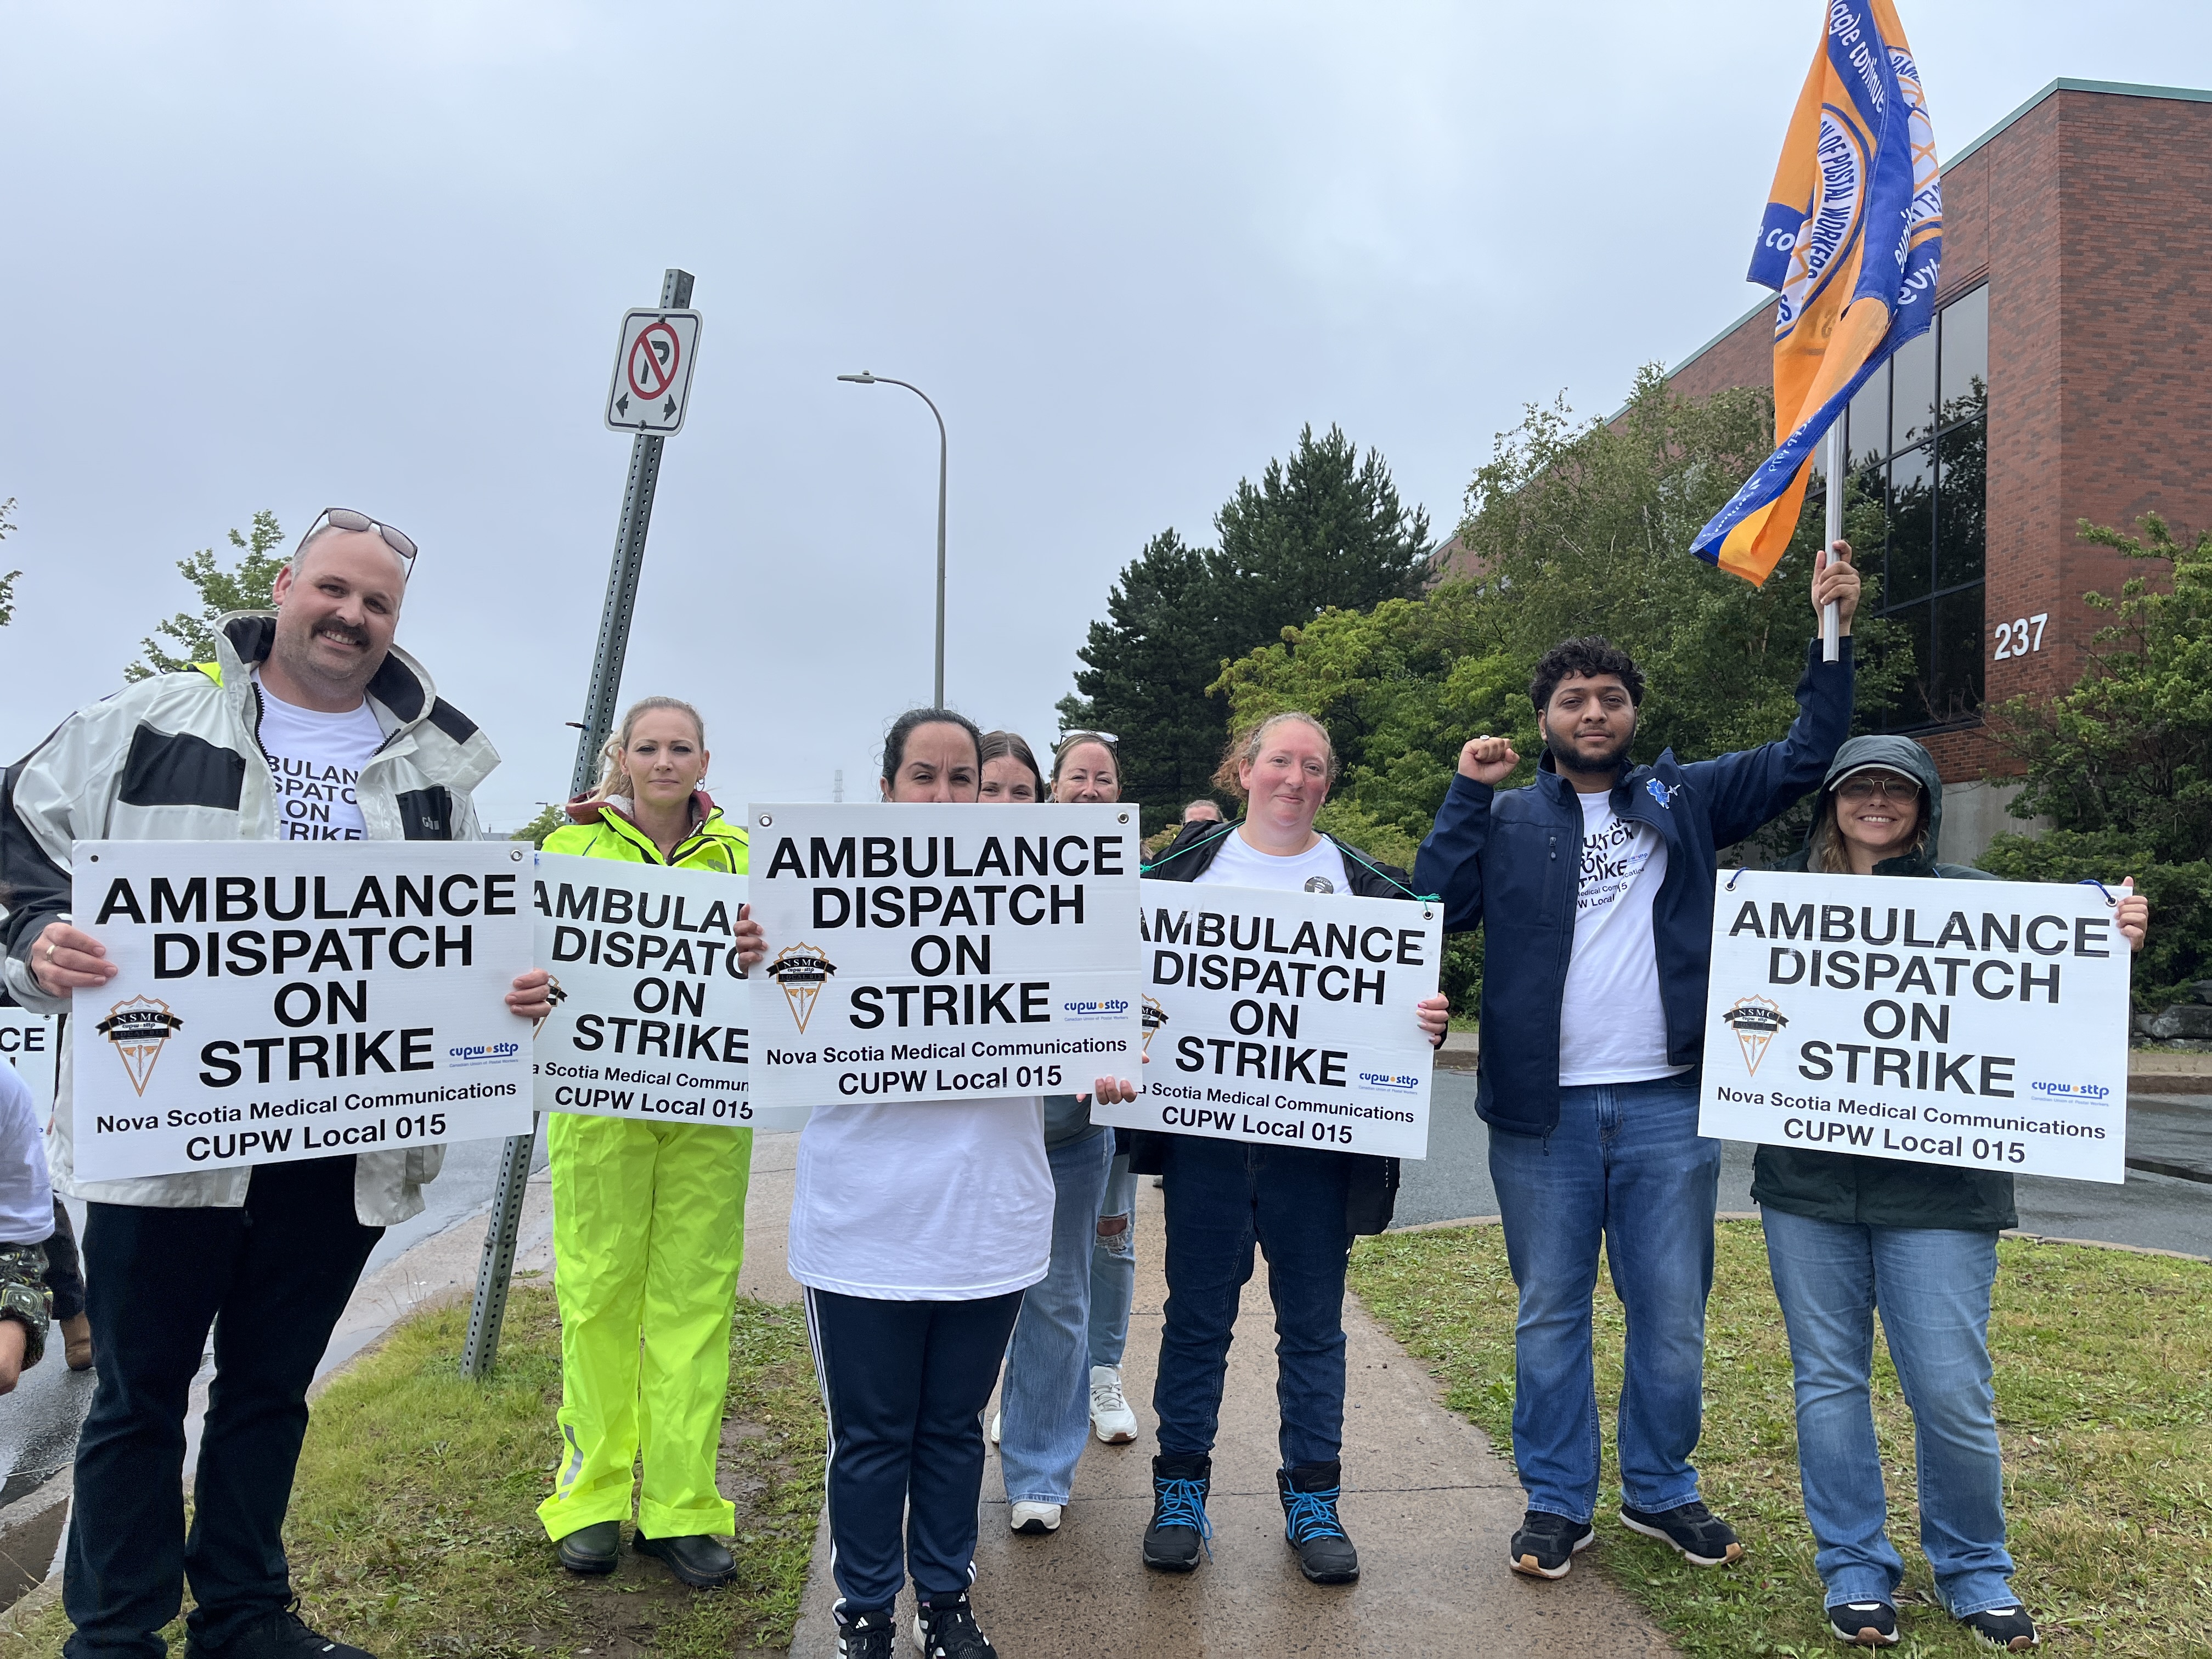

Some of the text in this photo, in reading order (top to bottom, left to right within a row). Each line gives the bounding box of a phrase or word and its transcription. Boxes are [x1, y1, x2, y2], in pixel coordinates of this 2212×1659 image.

[1821, 153, 1854, 202] POSTAL
[1994, 613, 2047, 661] 237
[280, 820, 362, 840] RIKE
[286, 800, 329, 822] ON
[766, 835, 1124, 879] AMBULANCE
[95, 873, 516, 925] AMBULANCE
[813, 884, 1084, 929] DISPATCH
[1591, 894, 1615, 906] Local
[154, 924, 472, 979] DISPATCH
[1728, 901, 2110, 958] AMBULANCE
[783, 959, 821, 968] NSMC
[911, 934, 990, 977] ON
[1153, 950, 1385, 1005] DISPATCH
[1769, 947, 2060, 1003] DISPATCH
[116, 1013, 164, 1025] NSMC
[274, 980, 367, 1028] ON
[633, 977, 706, 1018] ON
[849, 981, 1051, 1029] STRIKE
[1230, 999, 1299, 1040] ON
[573, 1014, 749, 1064] STRIKE
[1864, 999, 1949, 1044] ON
[199, 1027, 434, 1088] STRIKE
[767, 1037, 1127, 1065] Nova Scotia Medical Communications
[1175, 1036, 1348, 1089] STRIKE
[1798, 1041, 2015, 1099] STRIKE
[545, 1062, 599, 1080] Scotia
[604, 1067, 671, 1086] Medical
[838, 1065, 1062, 1095] CUPW Local 015
[97, 1082, 516, 1133] Nova Scotia Medical Communications
[555, 1086, 753, 1120] CUPW Local 015
[1152, 1082, 1201, 1100] Scotia
[1207, 1088, 1269, 1107] Medical
[1275, 1095, 1414, 1123] Communications
[1162, 1106, 1352, 1144] CUPW Local 015
[1718, 1086, 2105, 1139] Nova Scotia Medical Communications
[186, 1113, 446, 1161] CUPW Local 015
[1784, 1118, 2025, 1163] CUPW Local 015
